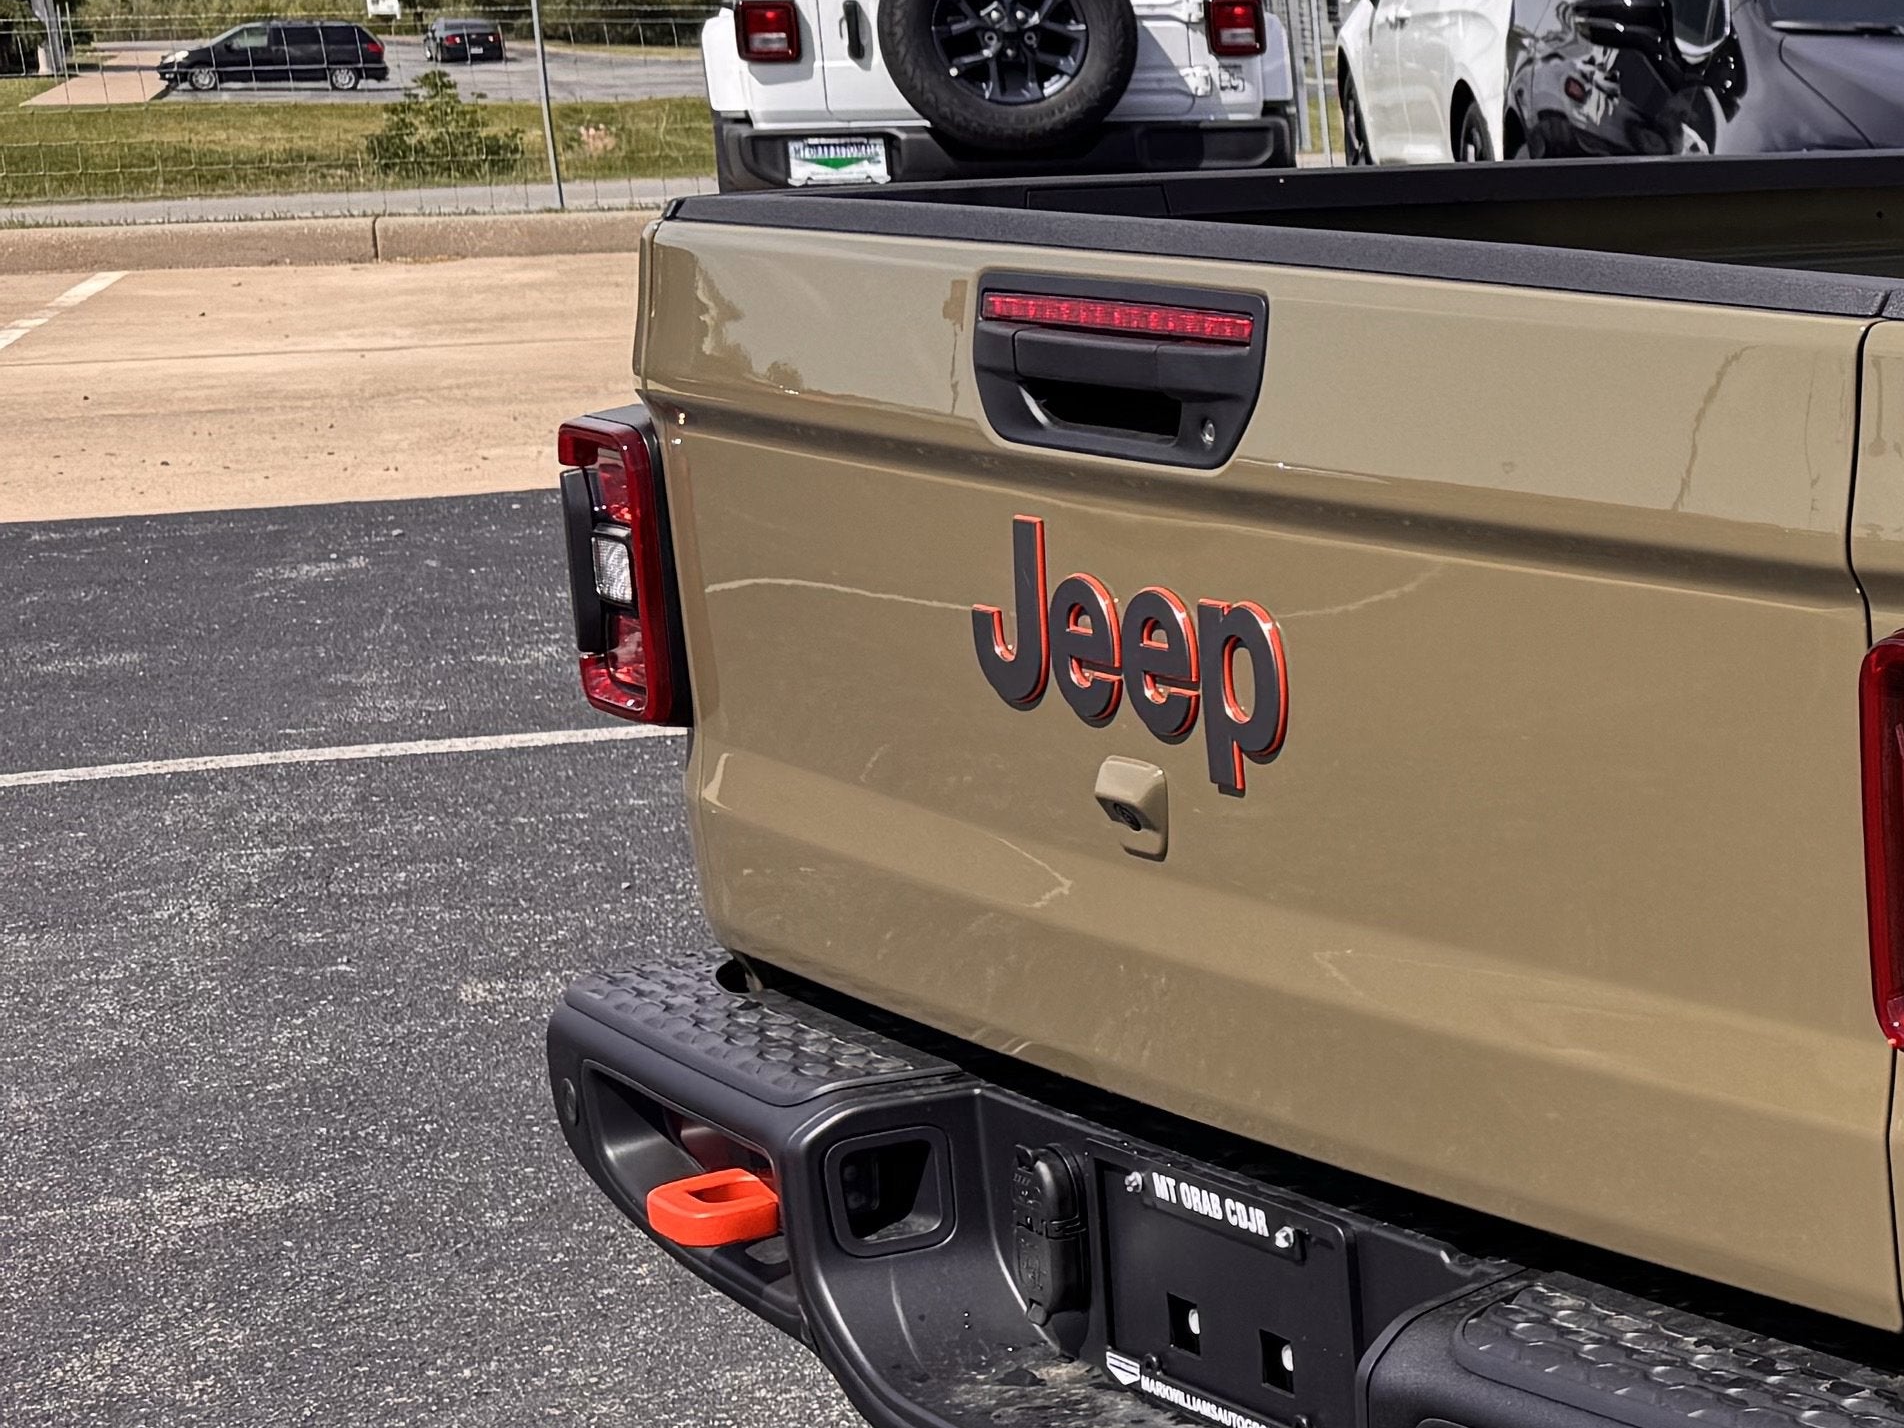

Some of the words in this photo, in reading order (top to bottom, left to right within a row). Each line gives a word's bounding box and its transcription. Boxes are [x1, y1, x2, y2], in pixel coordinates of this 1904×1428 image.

[971, 514, 1291, 794] Jeep
[1152, 1172, 1177, 1204] MT
[1179, 1182, 1223, 1220] ORAB
[1224, 1198, 1270, 1237] CDJR
